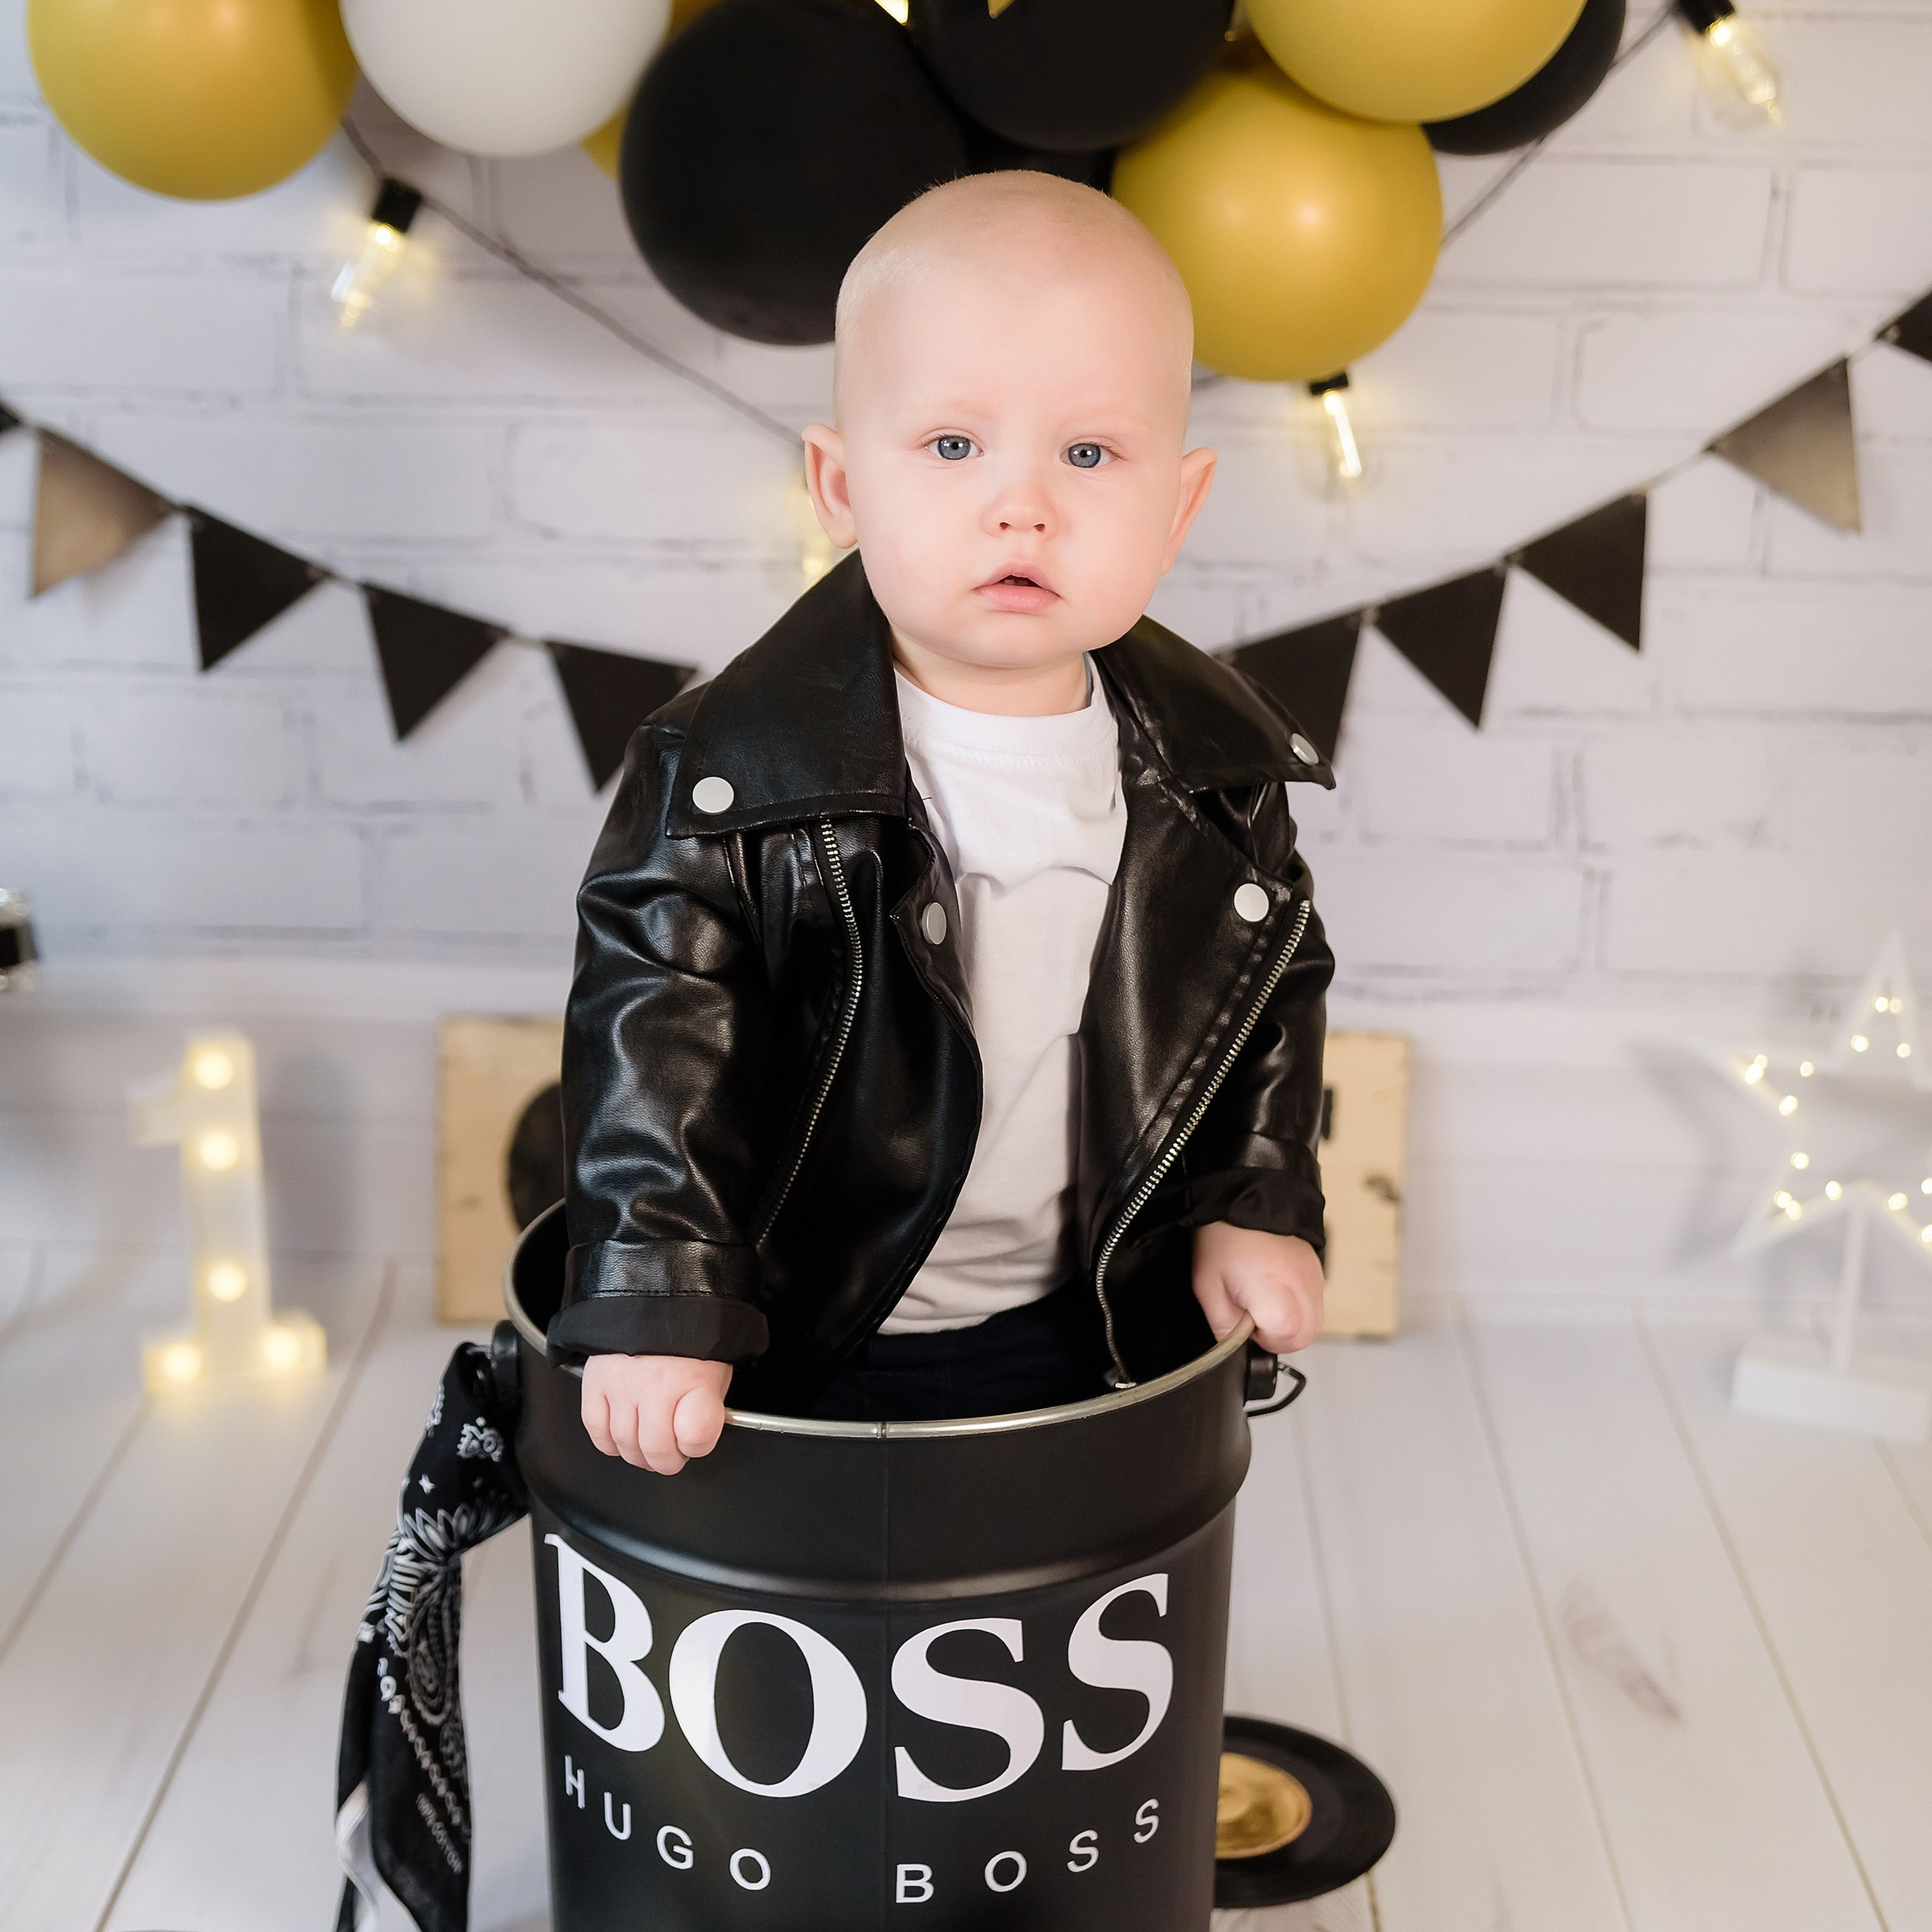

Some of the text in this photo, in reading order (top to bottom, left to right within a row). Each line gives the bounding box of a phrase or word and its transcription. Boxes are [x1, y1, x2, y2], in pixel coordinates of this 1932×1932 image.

[130, 1031, 325, 1392] 1
[544, 1534, 1173, 1801] BOSS
[565, 1755, 1159, 1903] HUGO BOSS
